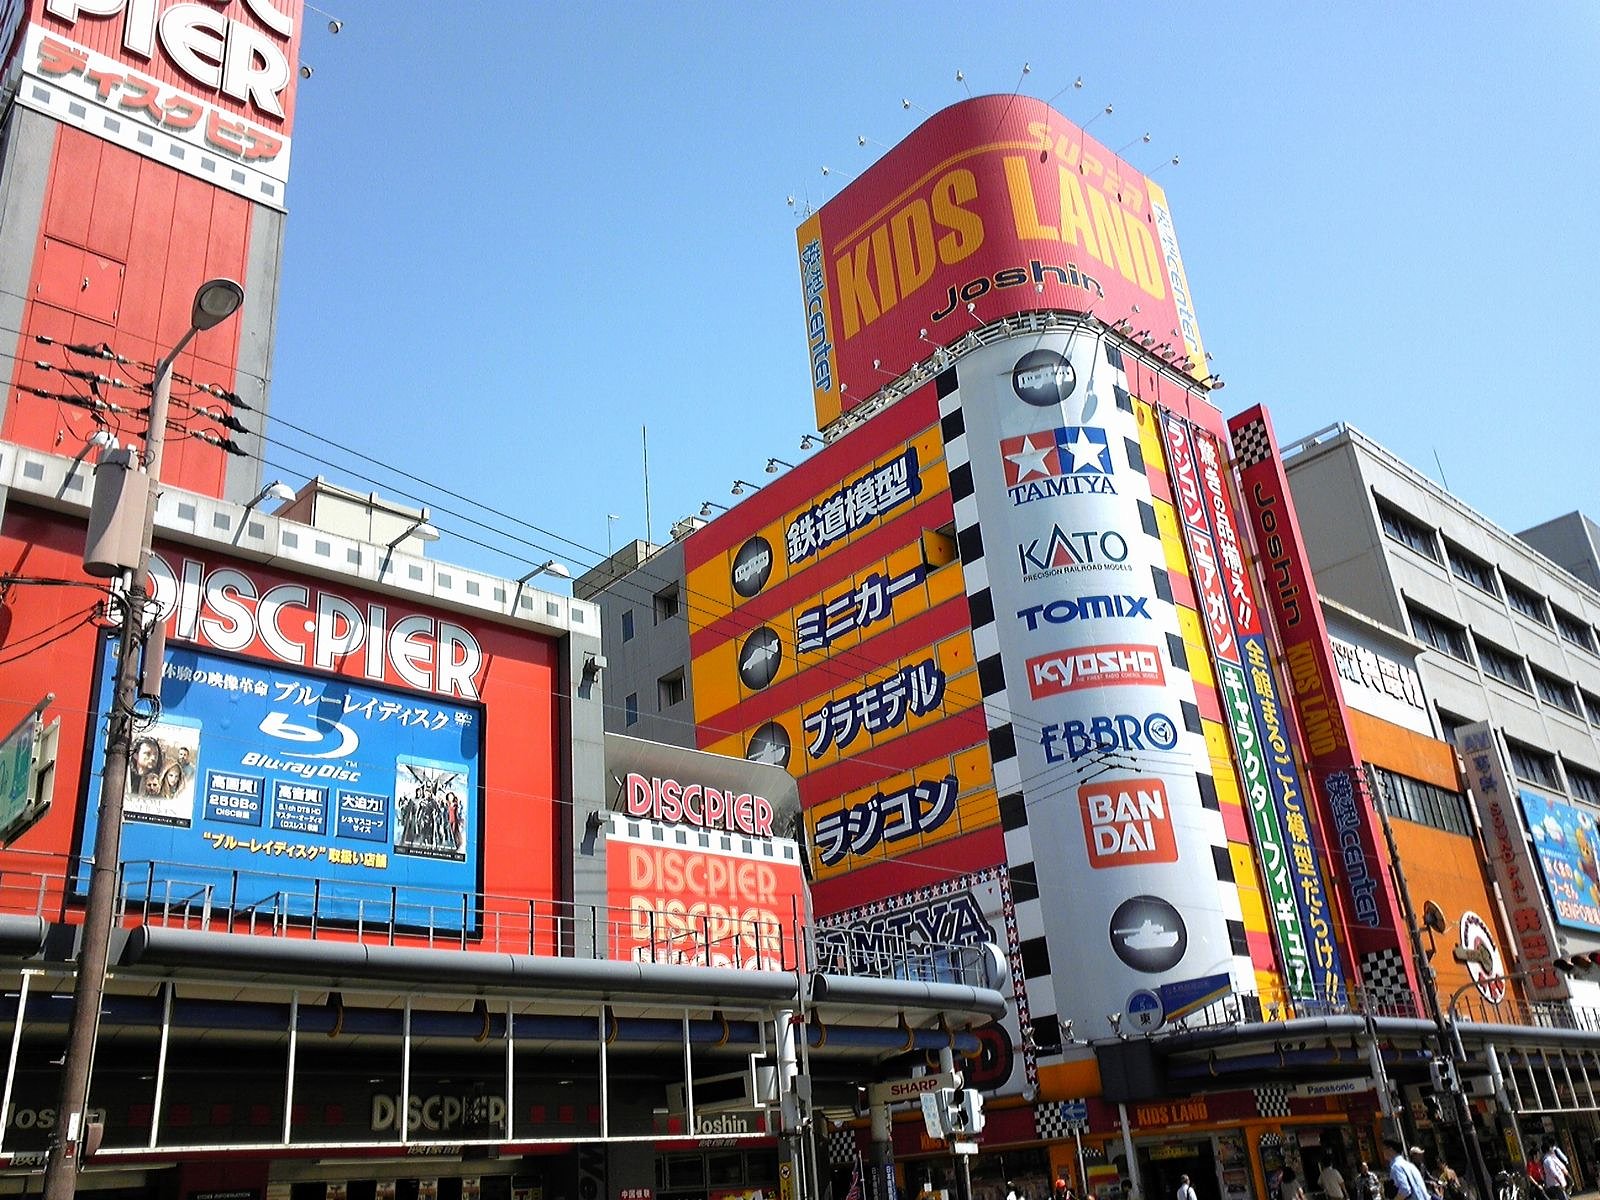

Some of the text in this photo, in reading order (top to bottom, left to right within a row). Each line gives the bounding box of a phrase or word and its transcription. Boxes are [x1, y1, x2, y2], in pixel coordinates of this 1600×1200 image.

[37, 36, 283, 160] ディスクピア
[1027, 122, 1144, 214] SUPER
[835, 155, 1166, 341] KIDS LAND
[930, 259, 1104, 323] Joshin
[1007, 475, 1118, 507] TAMIYA
[1166, 419, 1203, 525] ラジコン
[786, 455, 914, 565] 鉄道模型
[1017, 523, 1129, 575] KATO
[1023, 563, 1133, 583] PRECISION RAILROAD MODELS
[1253, 482, 1303, 629] Joshin
[797, 571, 917, 654] ミニカー
[1016, 594, 1153, 632] TOMIX
[1188, 536, 1233, 654] エアガン
[1032, 650, 1159, 687] KYOSHO
[273, 680, 450, 731] ブルーレイディスク
[803, 665, 938, 757] プラモデル
[1285, 640, 1337, 757] KIDS LAND
[1041, 711, 1178, 765] EBBRO
[317, 764, 361, 782] Disc
[352, 825, 372, 834] サイズ
[815, 782, 950, 866] ラジコン
[1088, 790, 1166, 825] BAN
[1223, 667, 1306, 993] キャラクターフィギュア
[1092, 819, 1157, 856] DAI
[891, 1079, 938, 1096] SHARP
[1137, 1107, 1170, 1126] KIDS
[1171, 1102, 1209, 1122] LAND
[1307, 1083, 1356, 1095] Panasonic
[694, 1114, 748, 1134] Joshin
